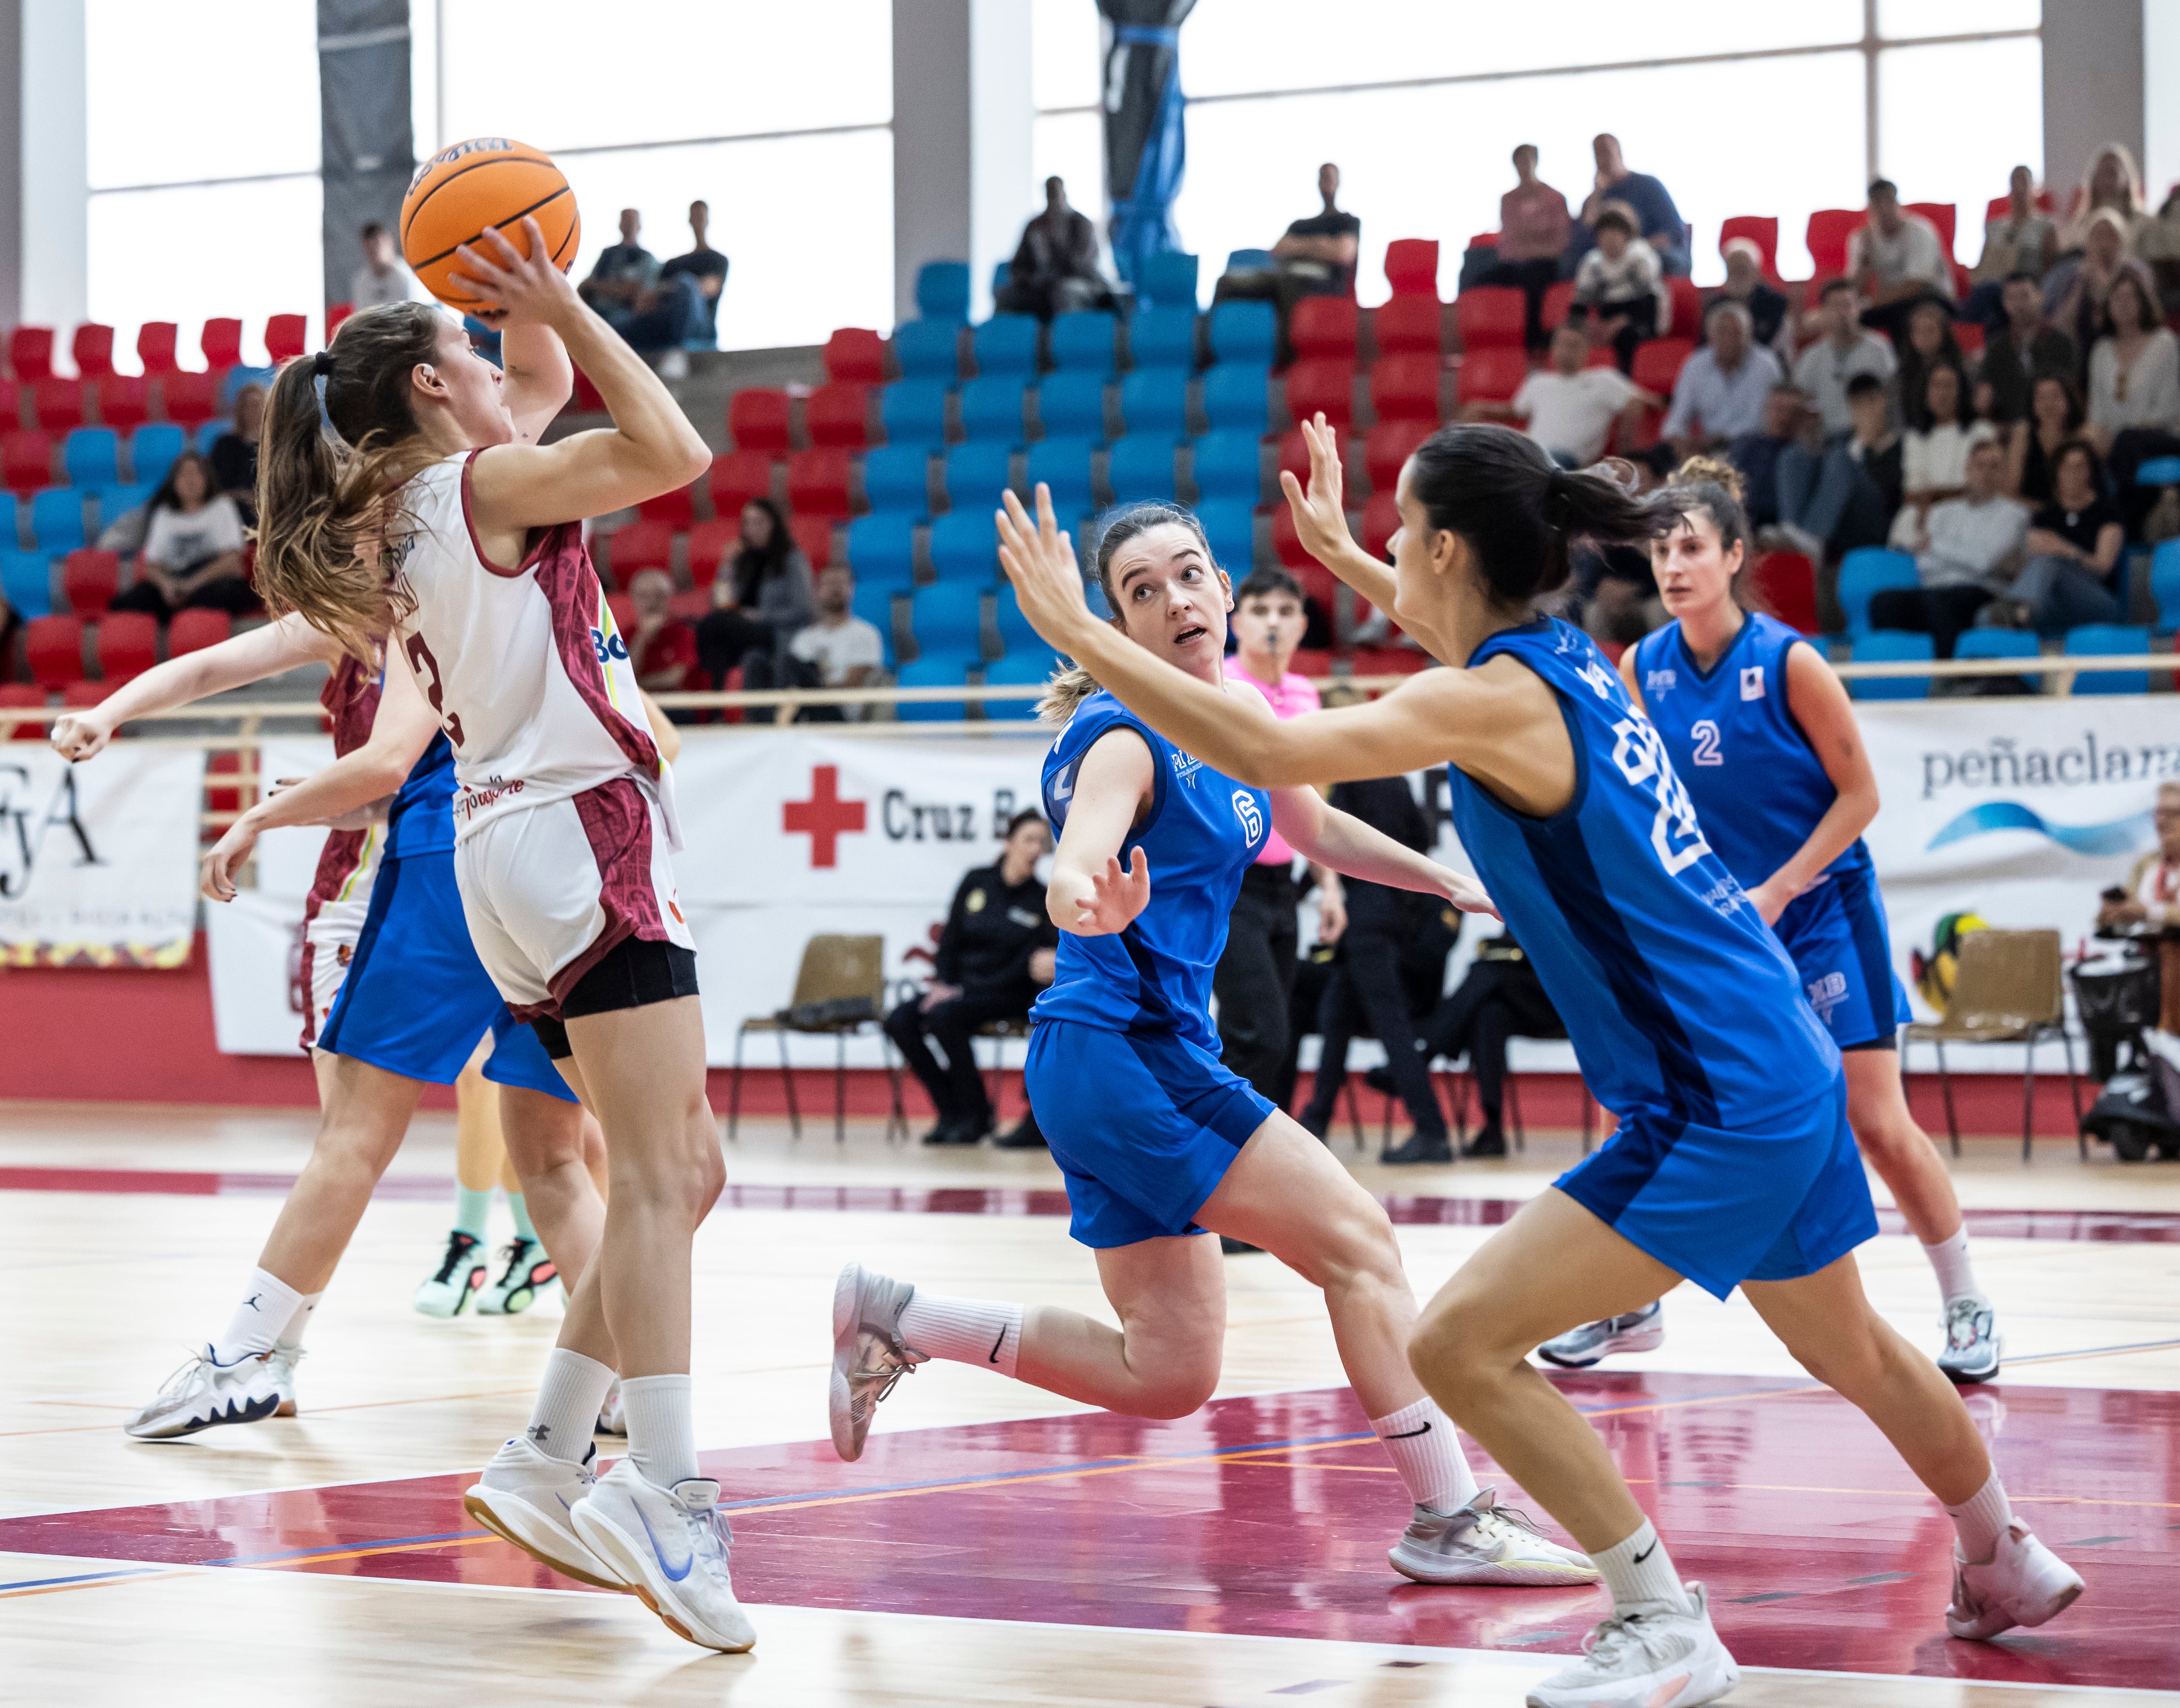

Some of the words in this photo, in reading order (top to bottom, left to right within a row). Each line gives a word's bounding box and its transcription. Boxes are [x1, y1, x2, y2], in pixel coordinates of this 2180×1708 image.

[406, 631, 465, 749] 2
[1691, 719, 1724, 766] 2
[882, 788, 977, 842] Cruz
[1232, 789, 1263, 848] 6
